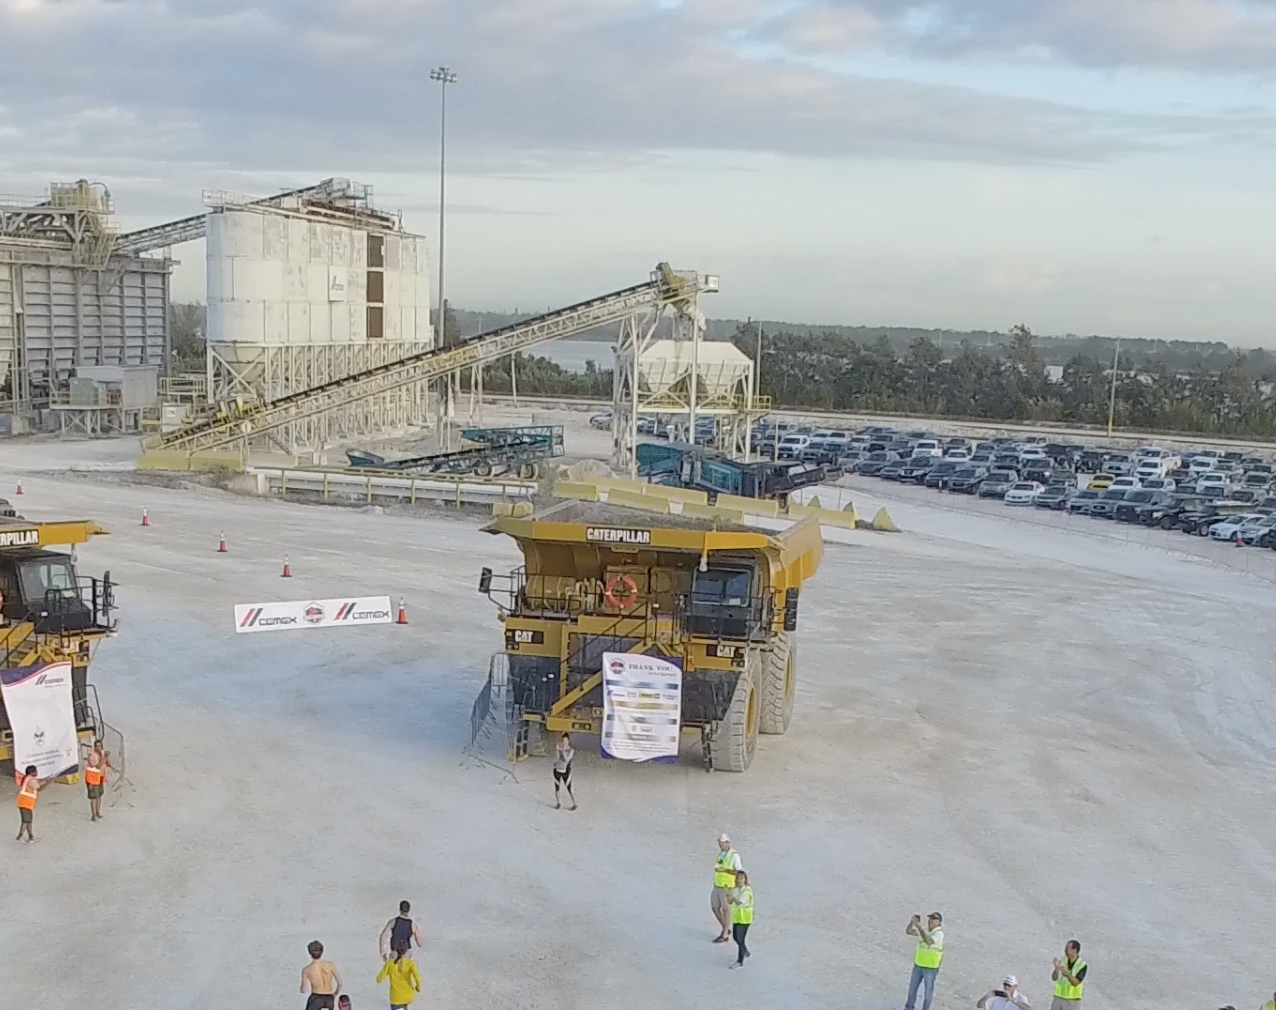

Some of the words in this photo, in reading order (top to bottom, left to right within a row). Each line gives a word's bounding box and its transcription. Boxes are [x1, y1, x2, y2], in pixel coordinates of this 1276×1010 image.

[587, 528, 650, 543] CATERPILLAR
[352, 610, 390, 620] CEMEX
[258, 616, 298, 626] CEMEX
[515, 630, 533, 642] CAT
[717, 645, 735, 657] CAT
[628, 663, 654, 671] THANK
